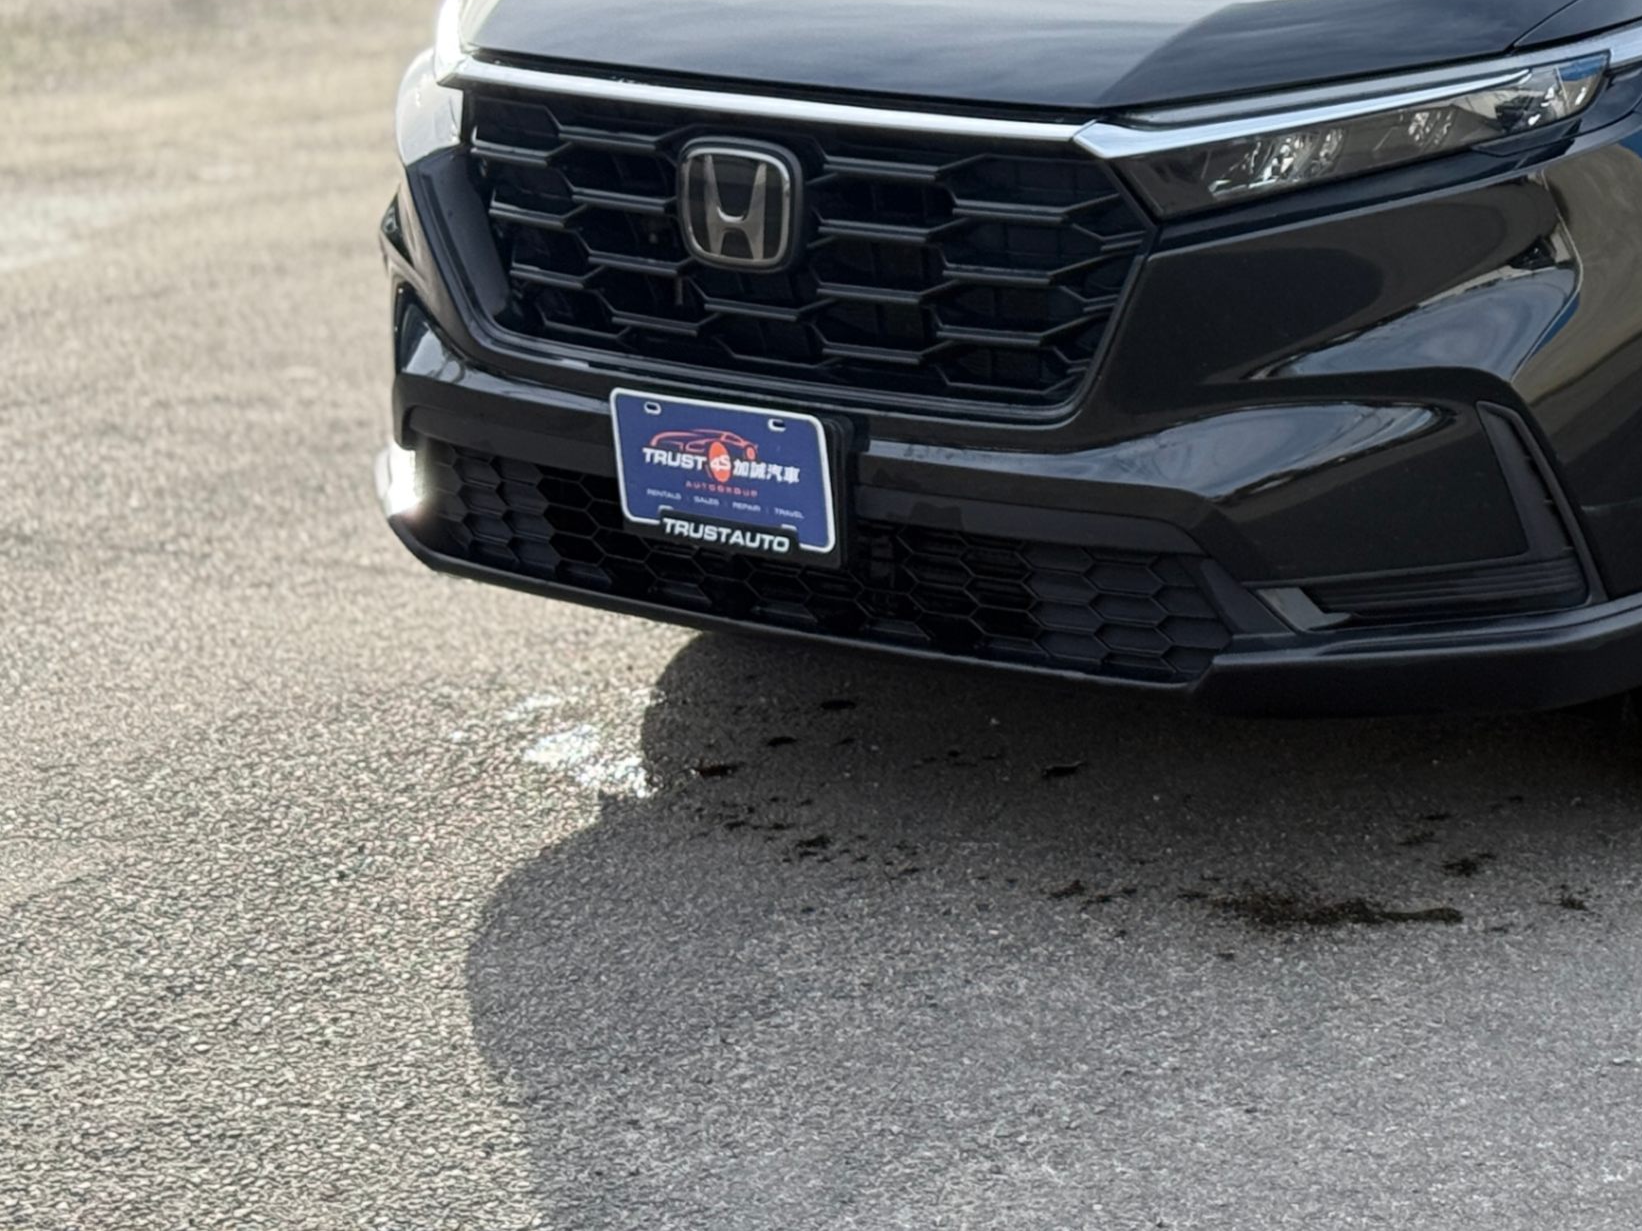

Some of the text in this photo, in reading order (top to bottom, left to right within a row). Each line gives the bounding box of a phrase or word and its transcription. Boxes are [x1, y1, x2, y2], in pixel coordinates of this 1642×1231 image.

[642, 447, 707, 471] TRUST
[646, 488, 805, 520] RENTALS SALES REPAIR TRAVEL
[662, 517, 790, 553] TRUSTAUTO
